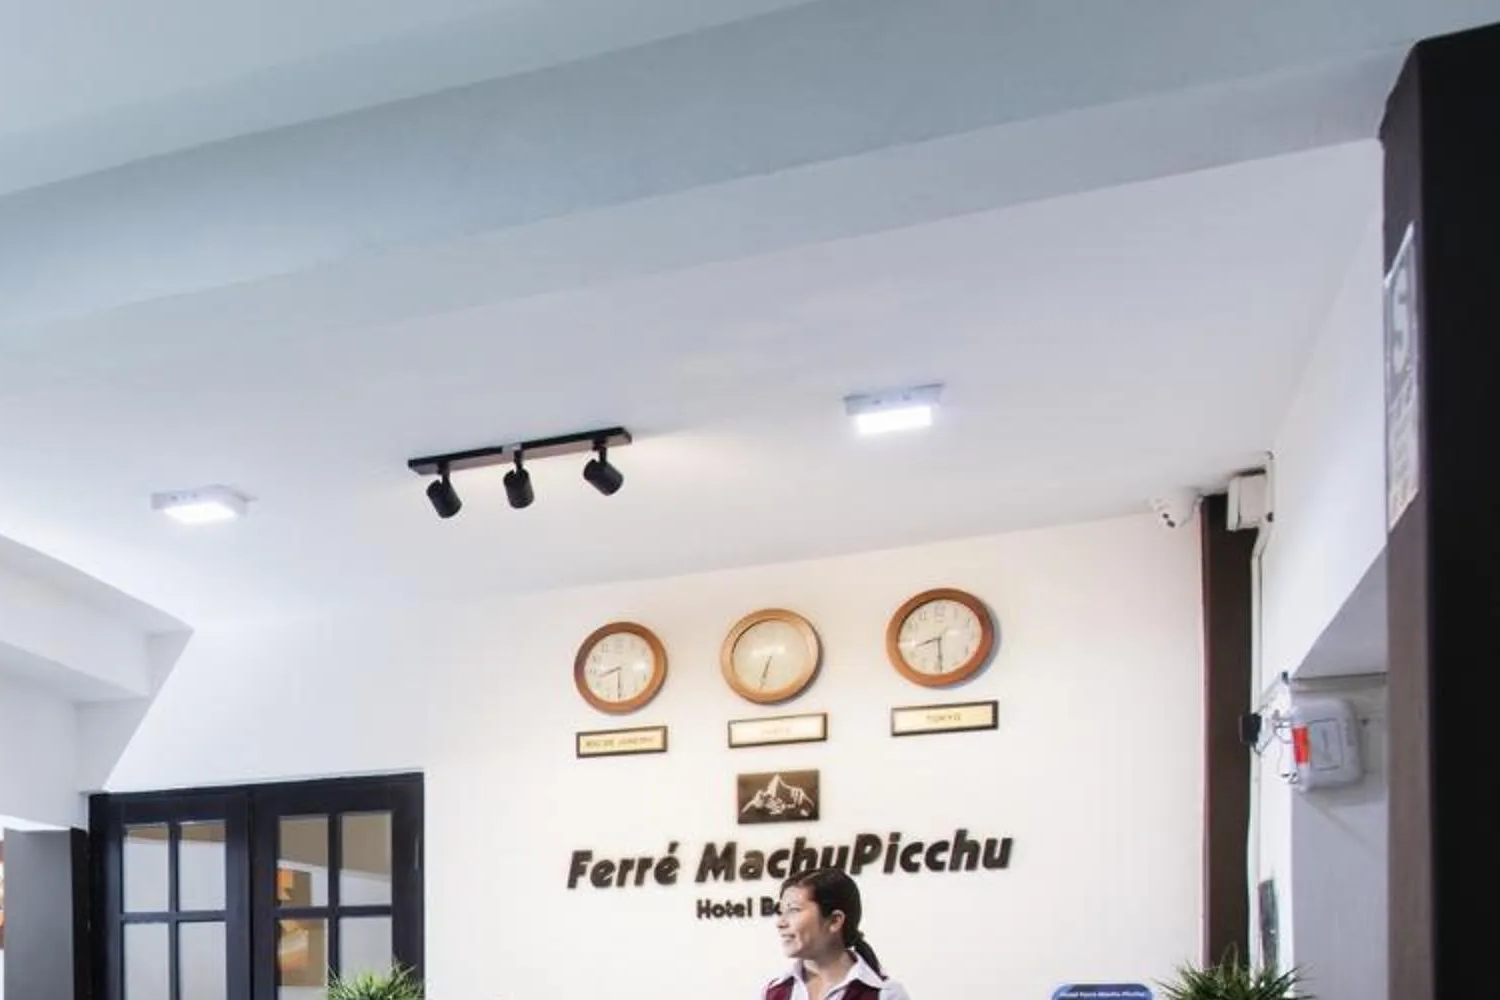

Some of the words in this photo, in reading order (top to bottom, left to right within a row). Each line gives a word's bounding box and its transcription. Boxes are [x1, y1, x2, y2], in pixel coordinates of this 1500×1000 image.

[567, 841, 680, 889] Ferré
[695, 829, 1014, 883] MachuPicchu
[696, 897, 753, 919] Hotel
